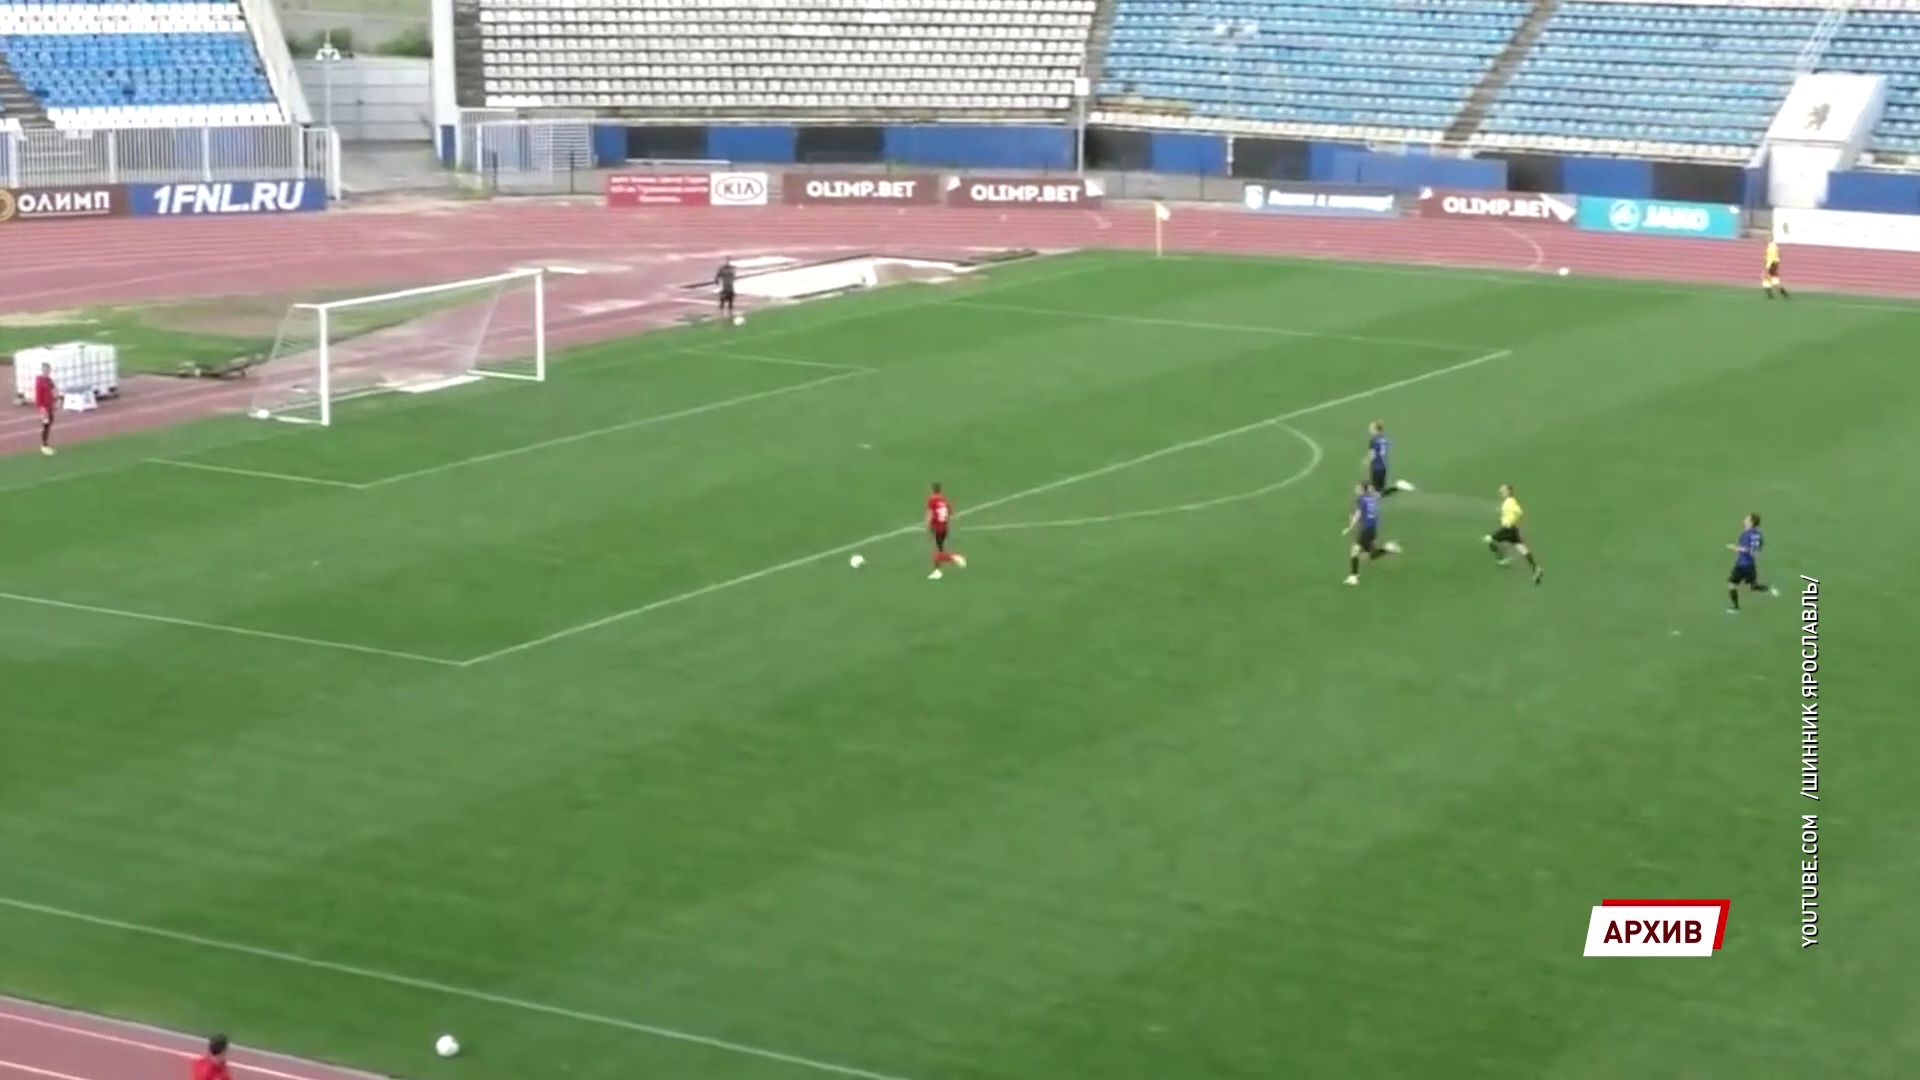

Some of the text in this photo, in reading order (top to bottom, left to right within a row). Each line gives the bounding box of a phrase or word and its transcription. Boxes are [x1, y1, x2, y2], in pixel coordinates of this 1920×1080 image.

[152, 181, 305, 214] 1FNL.RU
[722, 182, 756, 195] KIA
[806, 181, 917, 198] OLIMP.BET
[970, 184, 1081, 202] OLIMP.BET
[18, 191, 111, 212] ОЛИМП
[1441, 197, 1550, 218] OLIMP.BET
